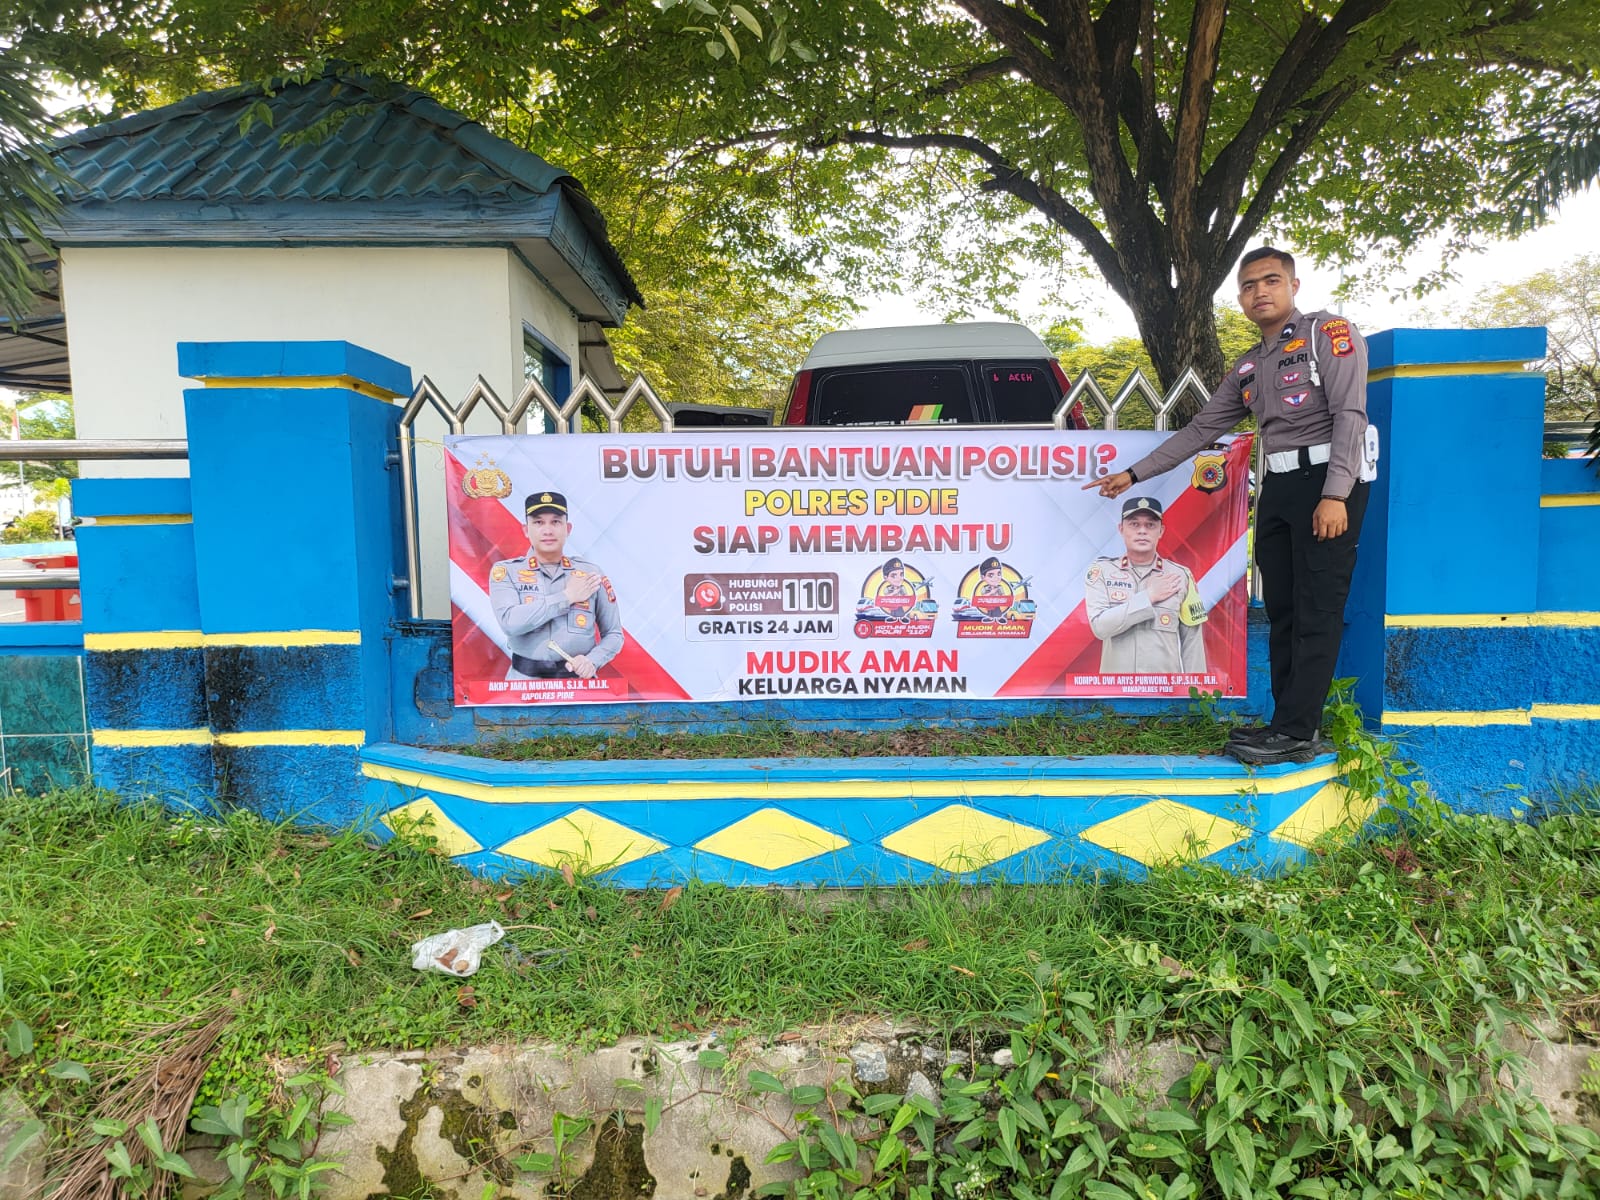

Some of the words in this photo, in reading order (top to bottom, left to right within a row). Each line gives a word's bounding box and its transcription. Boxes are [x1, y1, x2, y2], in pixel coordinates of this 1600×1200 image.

[1278, 353, 1308, 369] POLRI
[1008, 373, 1033, 382] ACEH
[602, 447, 742, 480] BUTUH
[751, 446, 952, 478] BANTUAN
[962, 445, 1087, 477] POLISI
[745, 489, 868, 516] POLRES
[874, 488, 959, 515] PIDIE
[692, 525, 780, 554] SIAP
[788, 524, 1012, 553] MEMBANTU
[518, 584, 539, 592] JAKA
[1106, 580, 1132, 588] D.ARYS
[729, 579, 779, 588] HUBUNGI
[784, 581, 833, 609] 110
[729, 591, 782, 600] LAYANAN
[729, 603, 763, 612] POLISI
[698, 620, 764, 635] GRATIS
[767, 620, 790, 634] 24
[793, 620, 833, 633] JAM
[746, 651, 852, 675] MUDIK
[859, 650, 959, 673] AMAN
[510, 681, 527, 691] JAKA
[738, 677, 859, 695] KELUARGA
[864, 676, 967, 694] NYAMAN
[1074, 676, 1100, 685] KOMPOL
[1117, 676, 1134, 685] ARYS
